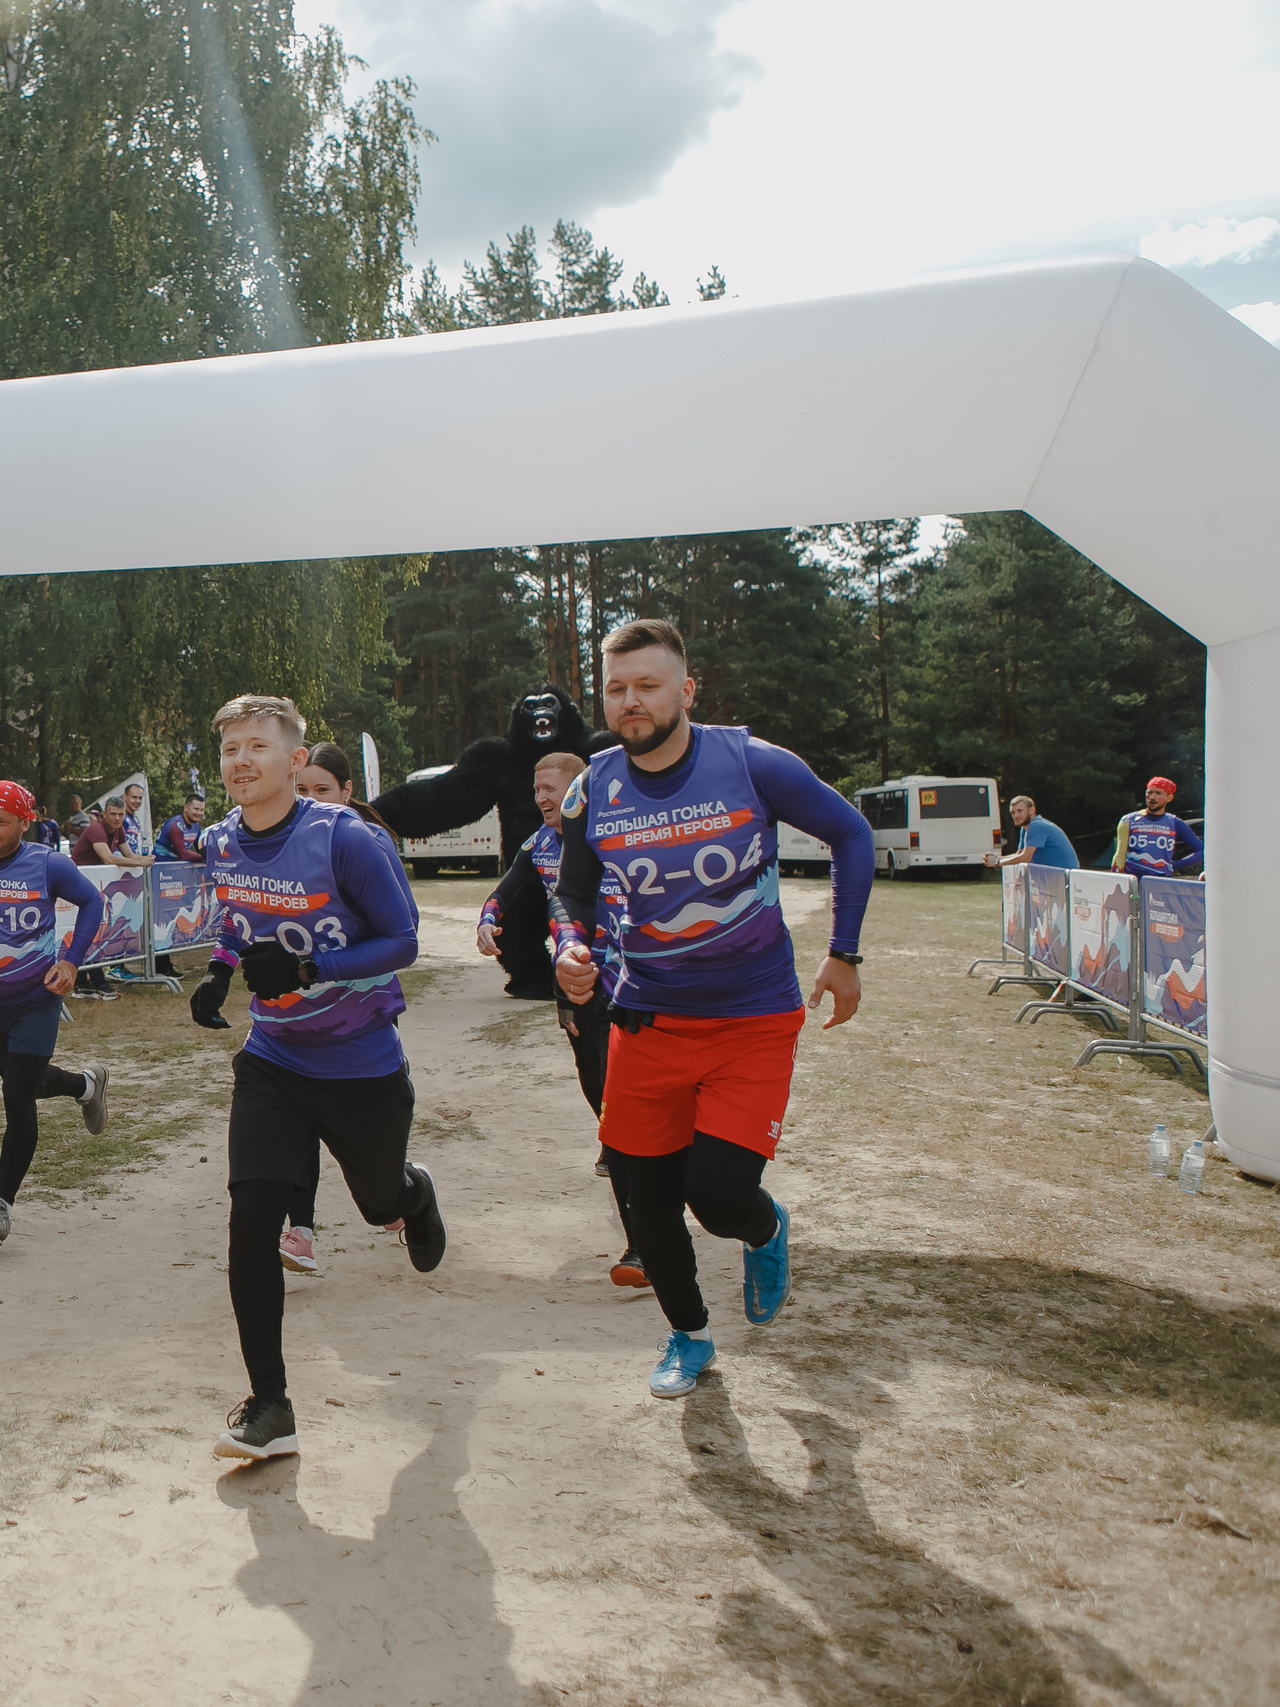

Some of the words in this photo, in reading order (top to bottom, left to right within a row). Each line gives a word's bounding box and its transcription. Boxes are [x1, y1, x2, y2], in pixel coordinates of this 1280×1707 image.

[595, 811, 669, 837] БОЛЬШАЯ
[671, 800, 728, 822] ГОНКА
[624, 826, 672, 847] ВРЕМЯ
[674, 815, 732, 837] ГЕРОЕВ
[1128, 834, 1176, 852] 05-03
[228, 888, 261, 904] ВРЕМЯ
[263, 893, 309, 909] ГЕРОЕВ
[261, 877, 306, 895] ГОНКА
[223, 906, 347, 957] 2-03
